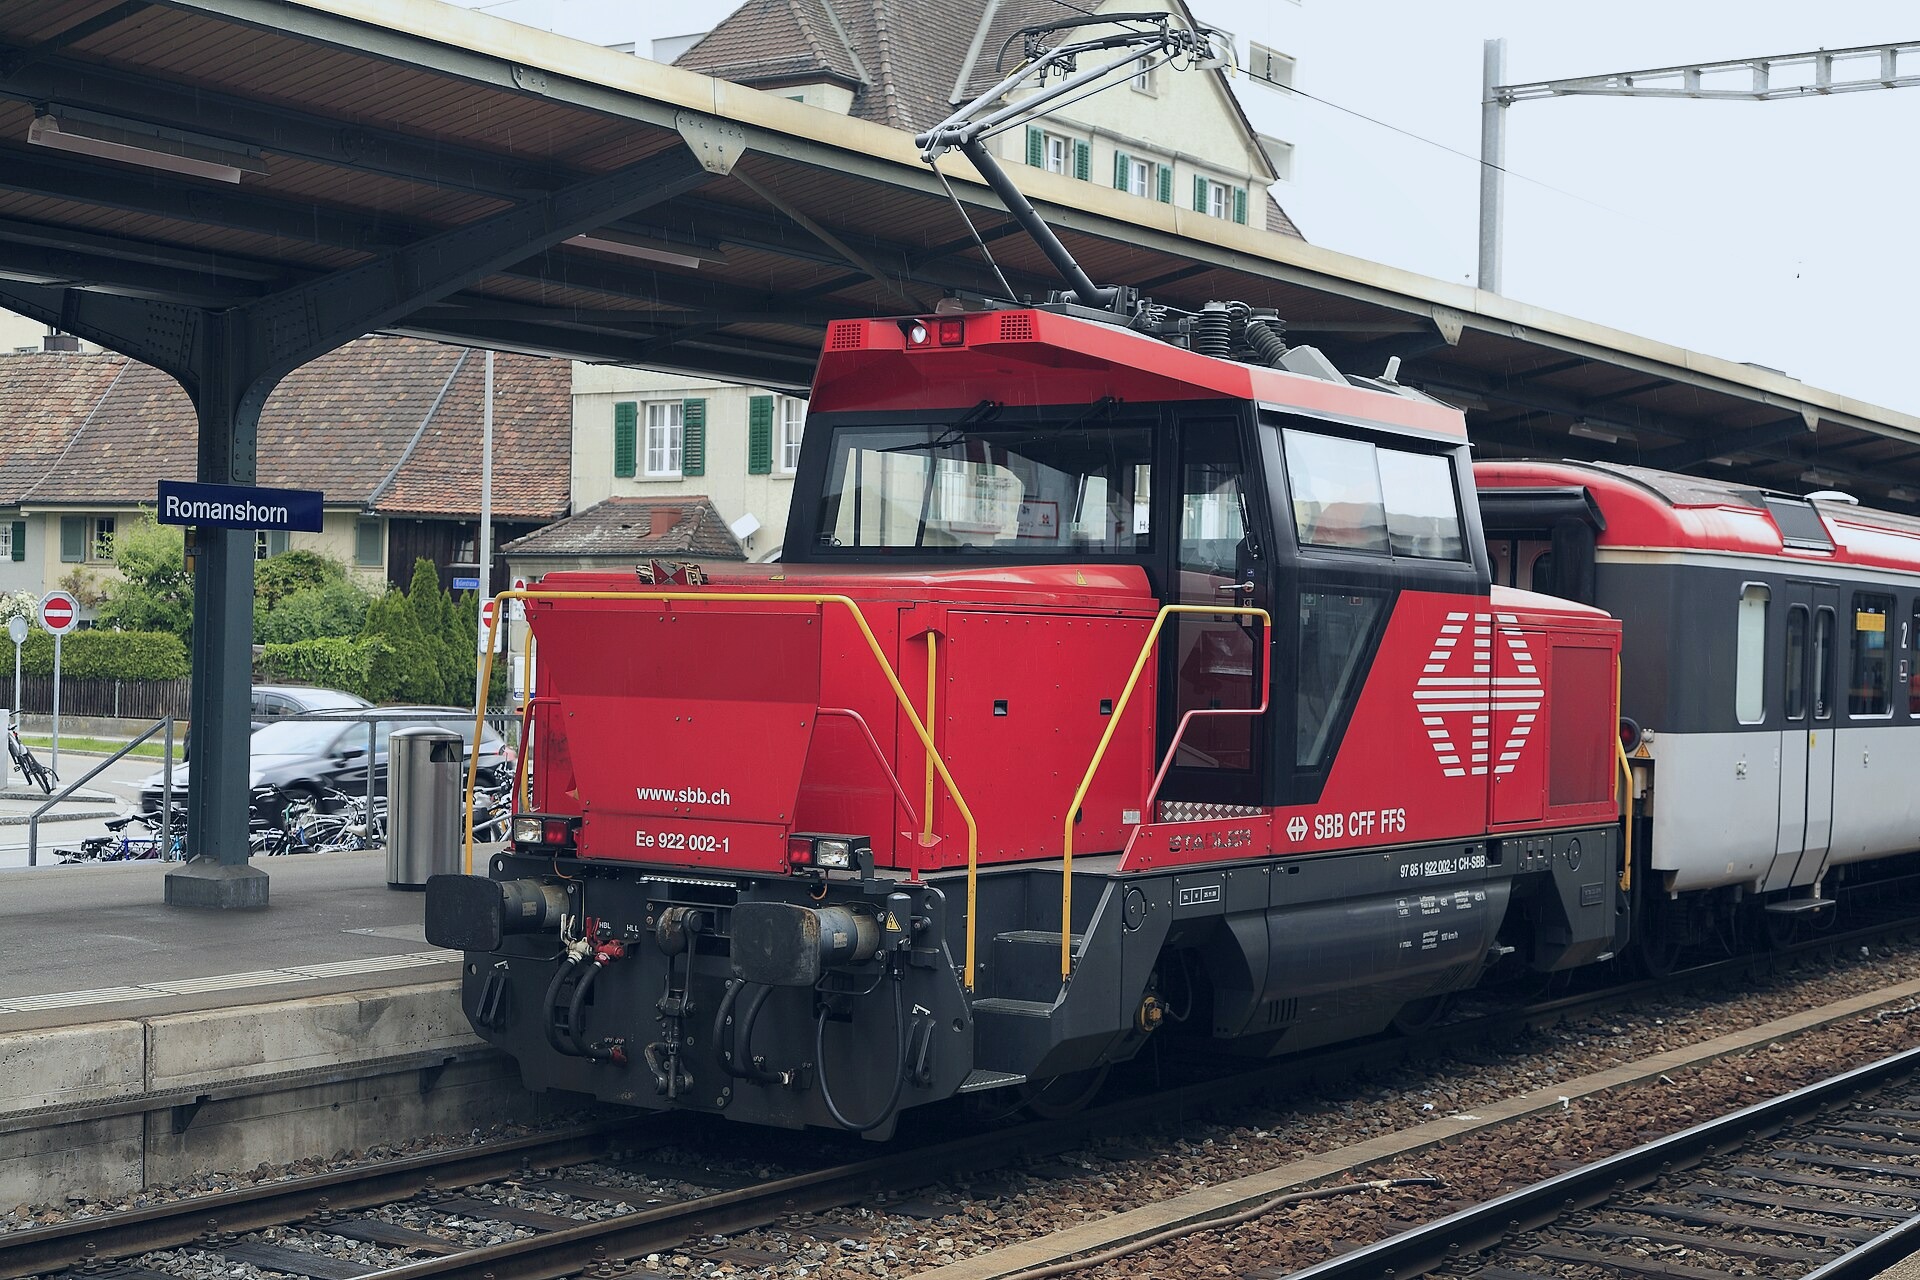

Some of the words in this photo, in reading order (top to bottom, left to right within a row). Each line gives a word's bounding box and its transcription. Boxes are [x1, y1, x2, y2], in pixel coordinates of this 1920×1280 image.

[166, 496, 288, 523] Romanshorn
[1901, 622, 1908, 649] 2
[636, 786, 731, 806] www.sbb.ch
[1314, 813, 1344, 840] SBB
[1348, 811, 1376, 837] CFF
[1380, 808, 1406, 834] FFS
[636, 830, 655, 848] Ee
[658, 832, 685, 850] 922
[688, 834, 730, 853] 002-1
[1400, 864, 1409, 878] 97
[1409, 863, 1419, 877] 85
[1419, 862, 1423, 875] 1
[1424, 860, 1438, 875] 922
[1438, 858, 1457, 873] 002-1
[1458, 855, 1486, 870] CH-SBB
